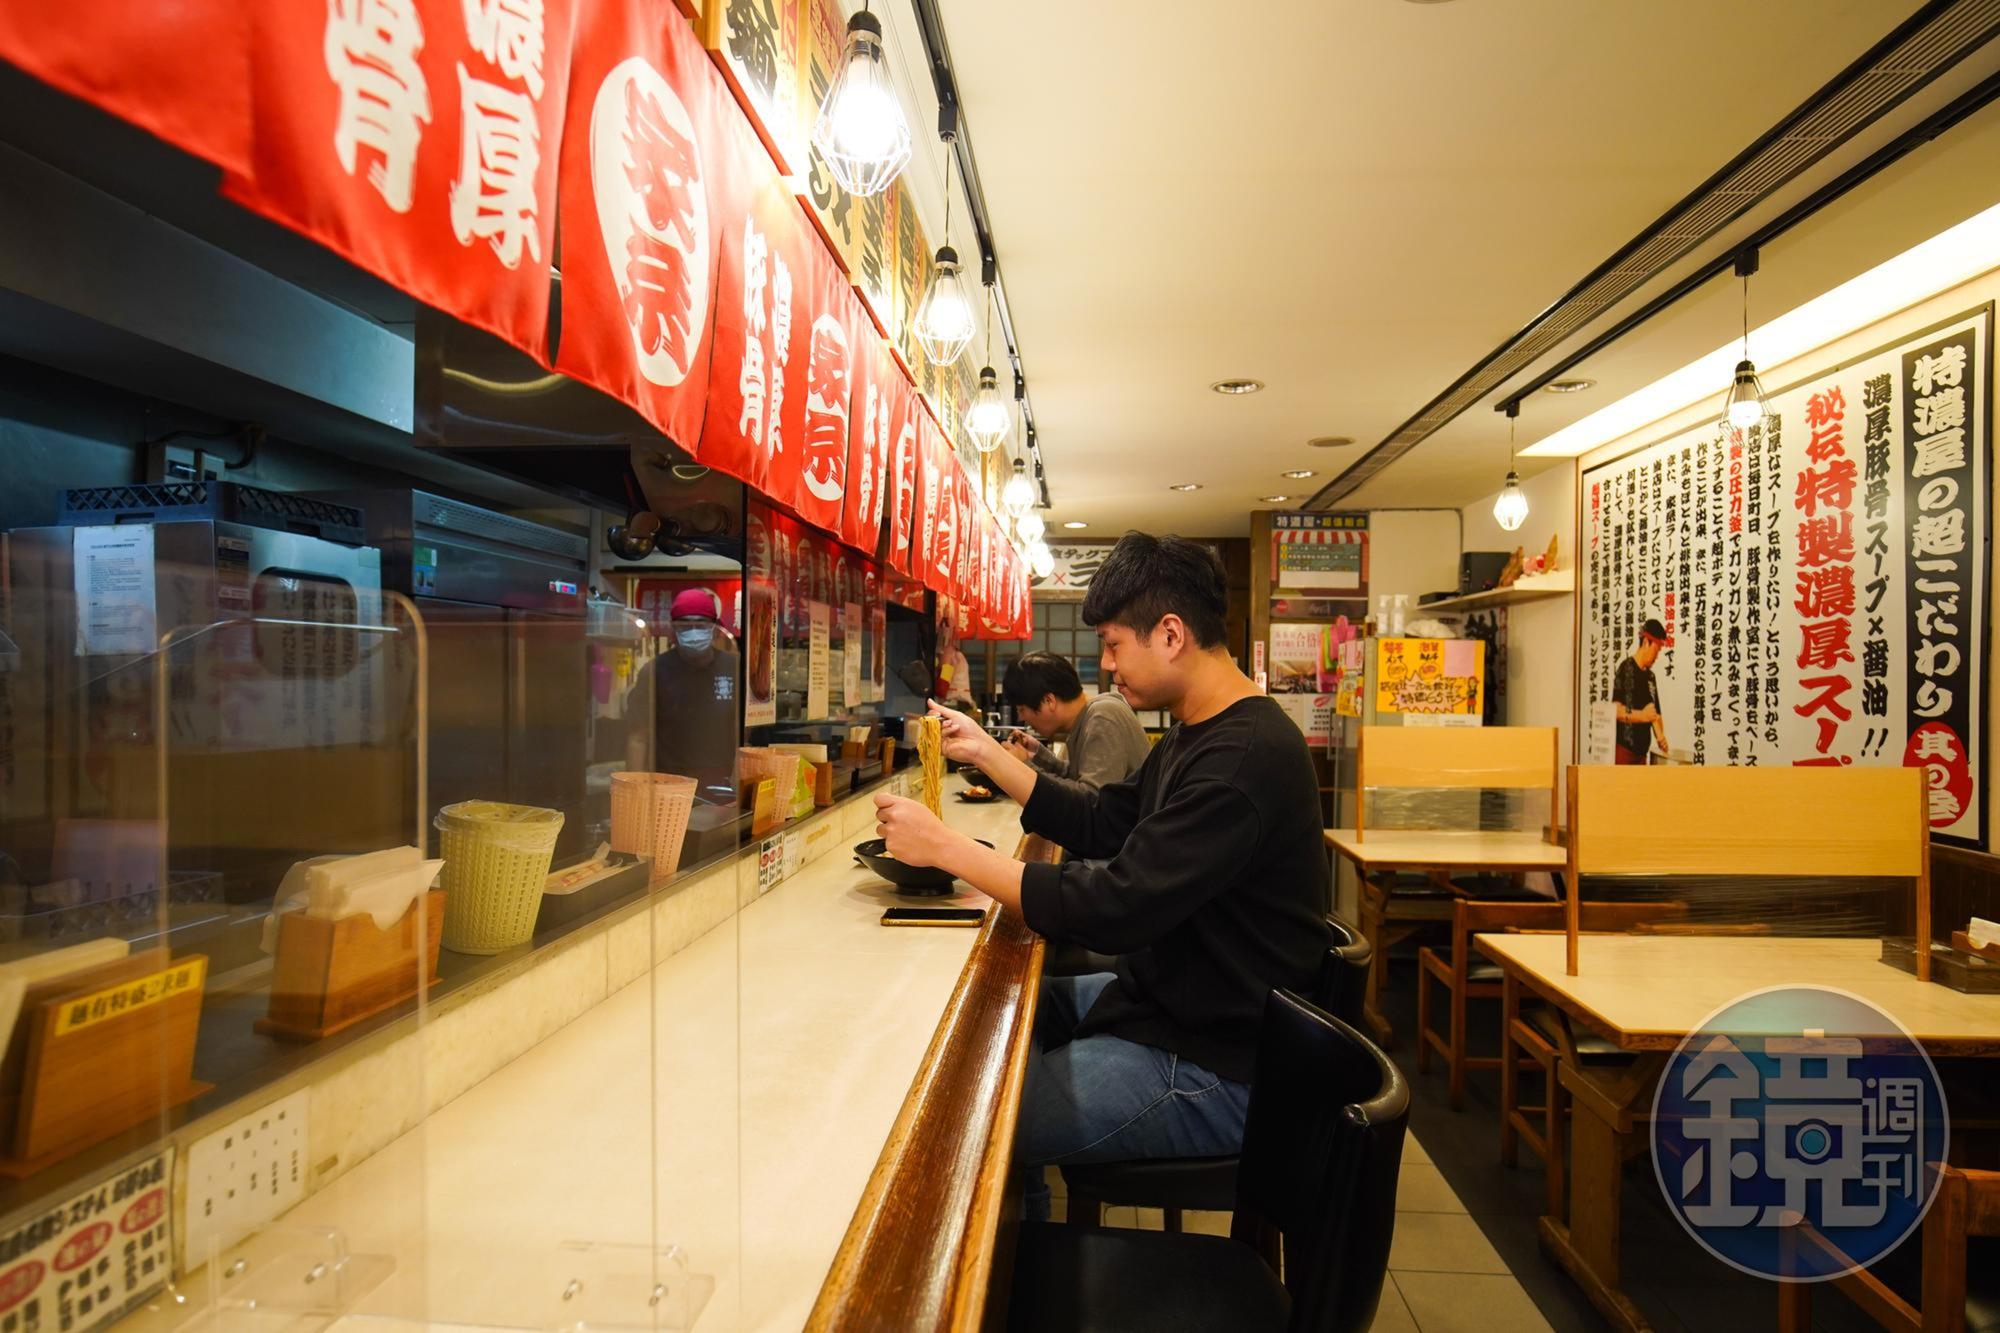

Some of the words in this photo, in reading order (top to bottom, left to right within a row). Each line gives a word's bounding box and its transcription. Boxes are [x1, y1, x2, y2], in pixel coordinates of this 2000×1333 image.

[1913, 345, 1966, 718] 特濃屋の超こだわり
